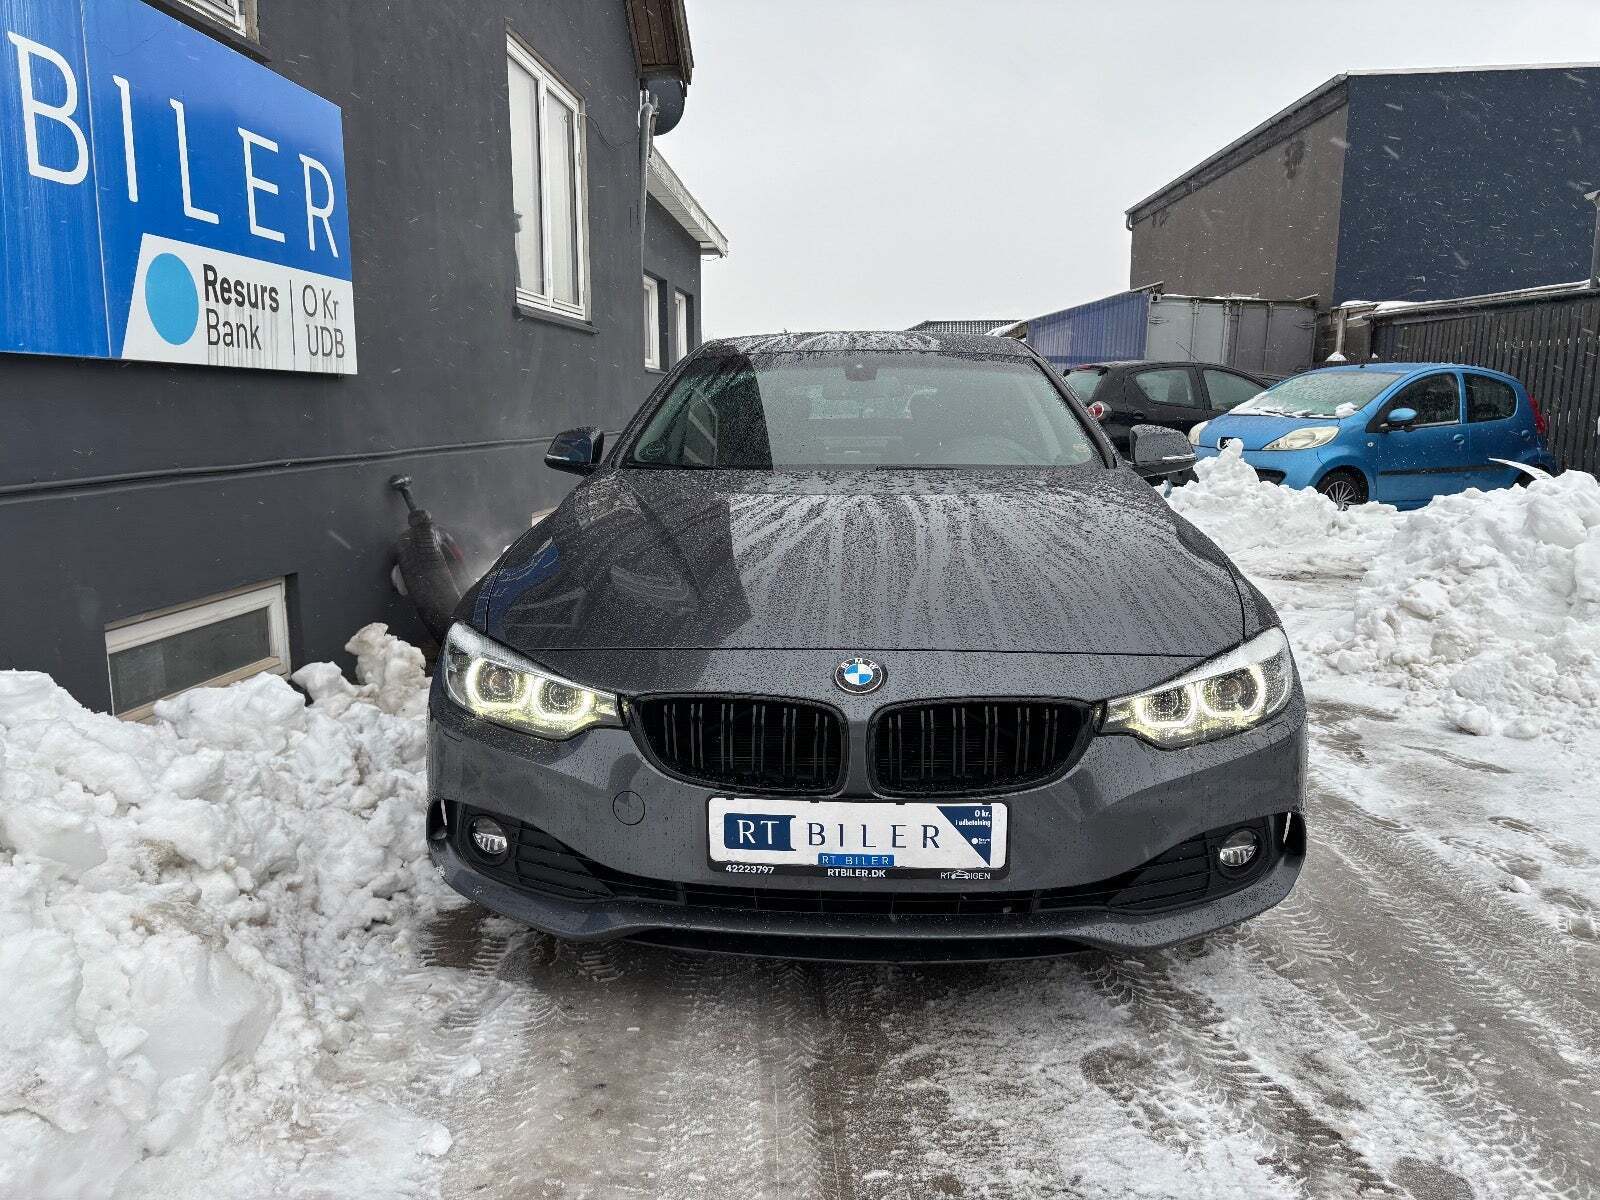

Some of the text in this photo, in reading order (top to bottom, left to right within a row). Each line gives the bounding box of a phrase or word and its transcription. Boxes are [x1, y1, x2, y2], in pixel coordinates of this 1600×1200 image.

[7, 30, 340, 259] BILER
[203, 263, 280, 313] Resurs
[321, 287, 340, 321] Kr
[205, 307, 263, 351] Bank
[306, 323, 346, 359] UDB
[736, 818, 941, 850] RT BILER
[725, 864, 775, 875] 42223797
[821, 855, 889, 866] RT BILER
[827, 867, 887, 878] RTBILER.DK
